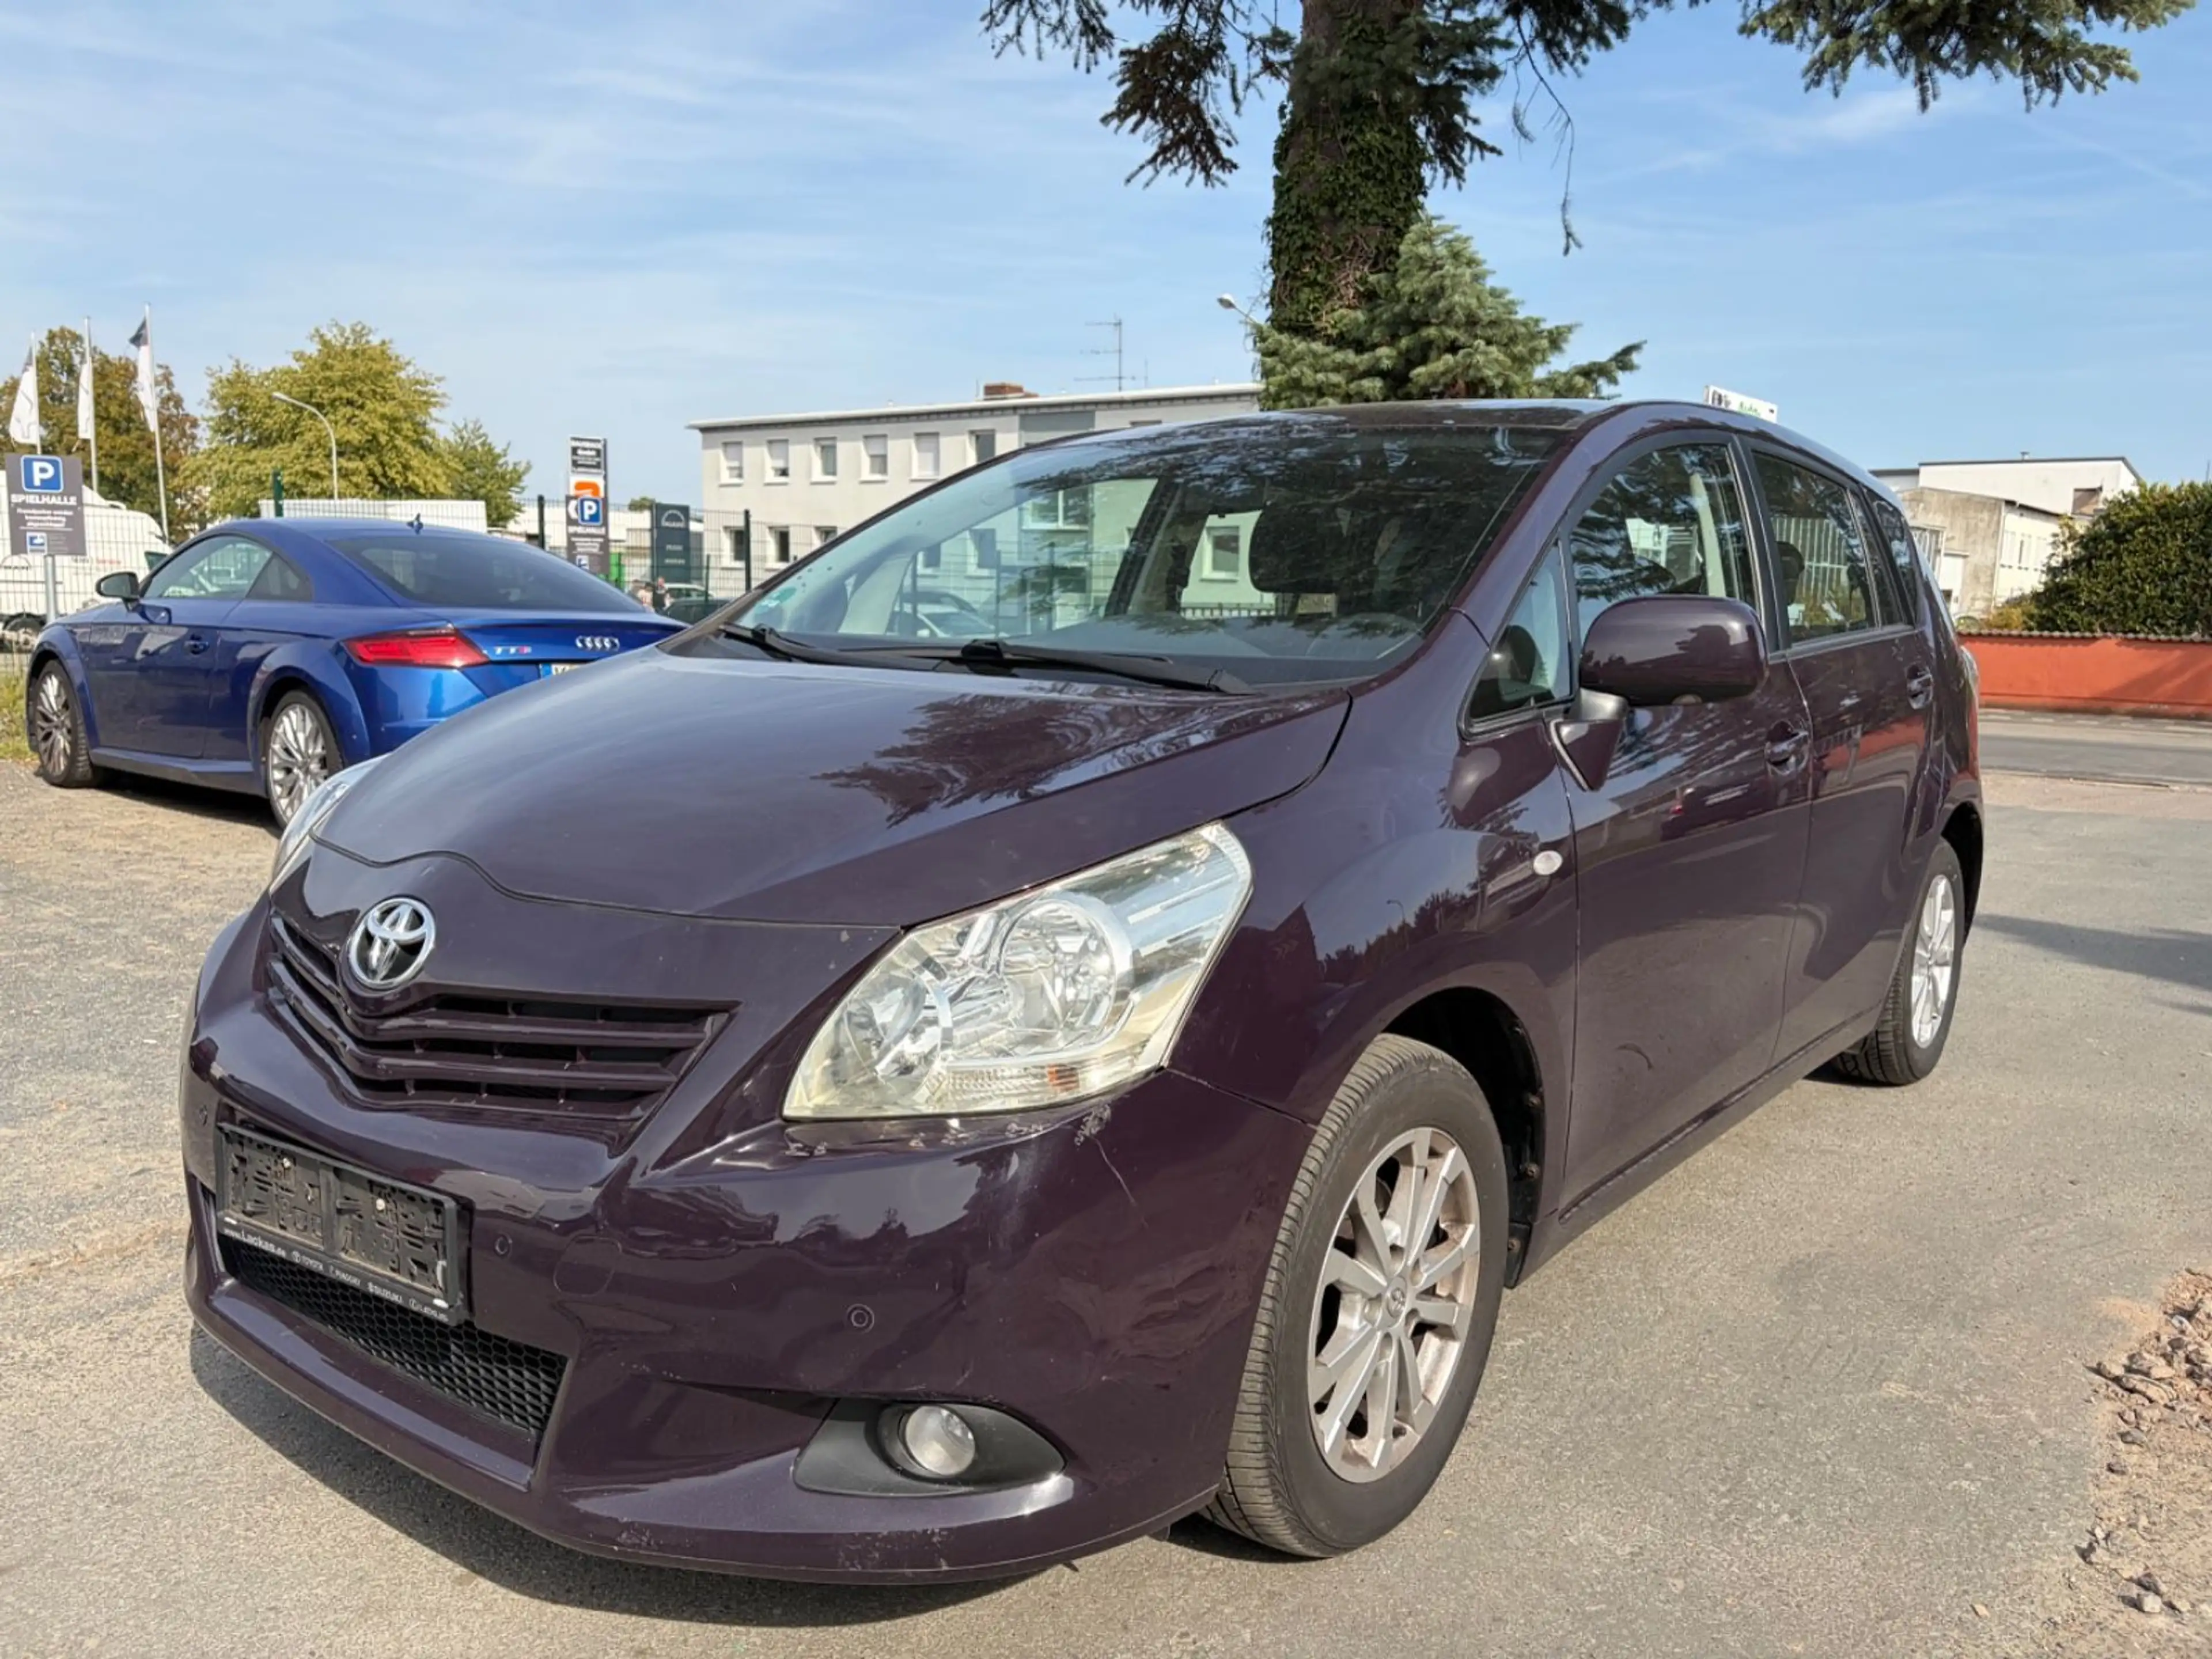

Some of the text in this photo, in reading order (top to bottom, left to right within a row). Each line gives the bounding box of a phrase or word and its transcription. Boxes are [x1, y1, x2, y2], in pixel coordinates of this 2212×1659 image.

[32, 461, 55, 487] P
[10, 493, 77, 505] SPIELHALLE
[583, 500, 597, 521] P
